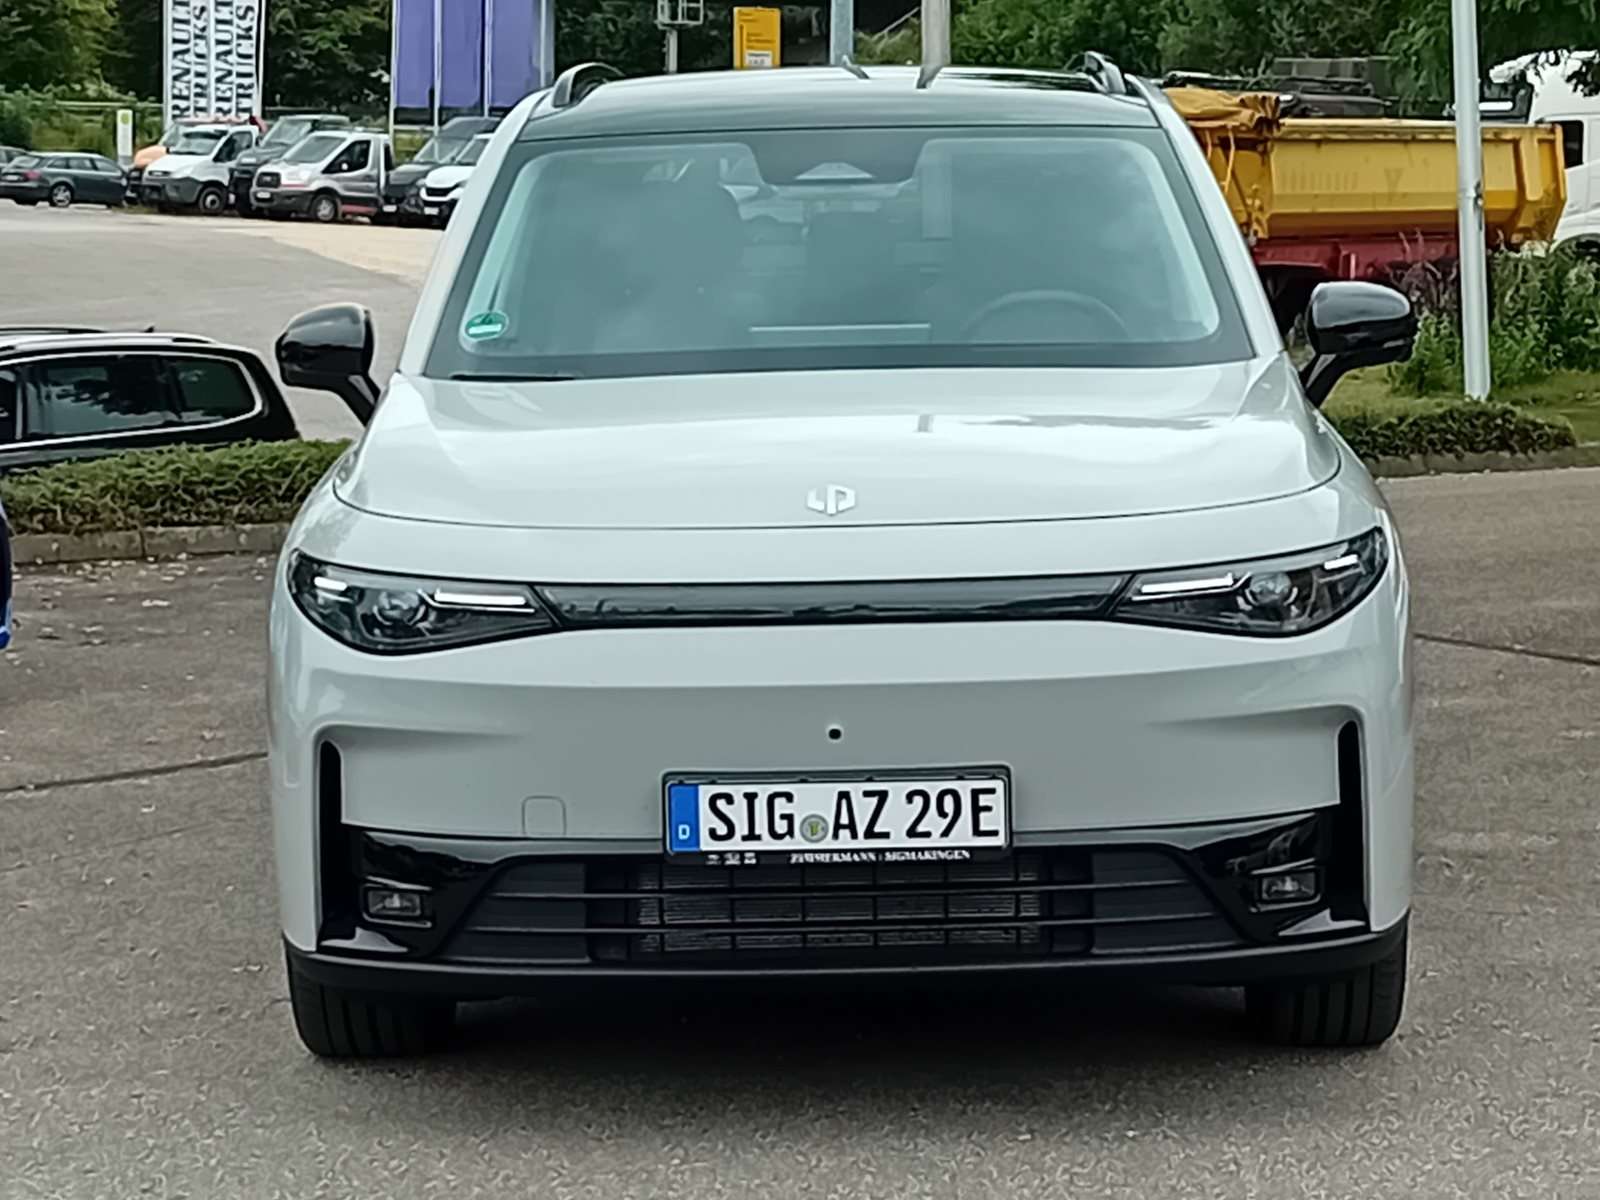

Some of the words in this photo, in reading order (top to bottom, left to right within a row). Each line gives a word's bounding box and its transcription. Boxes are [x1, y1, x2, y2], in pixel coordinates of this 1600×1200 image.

[193, 5, 208, 118] TRUCKS
[235, 5, 255, 117] TRUCKS
[678, 825, 691, 841] D
[707, 791, 796, 842] SIG
[831, 789, 891, 841] AZ
[905, 787, 1000, 839] 29E
